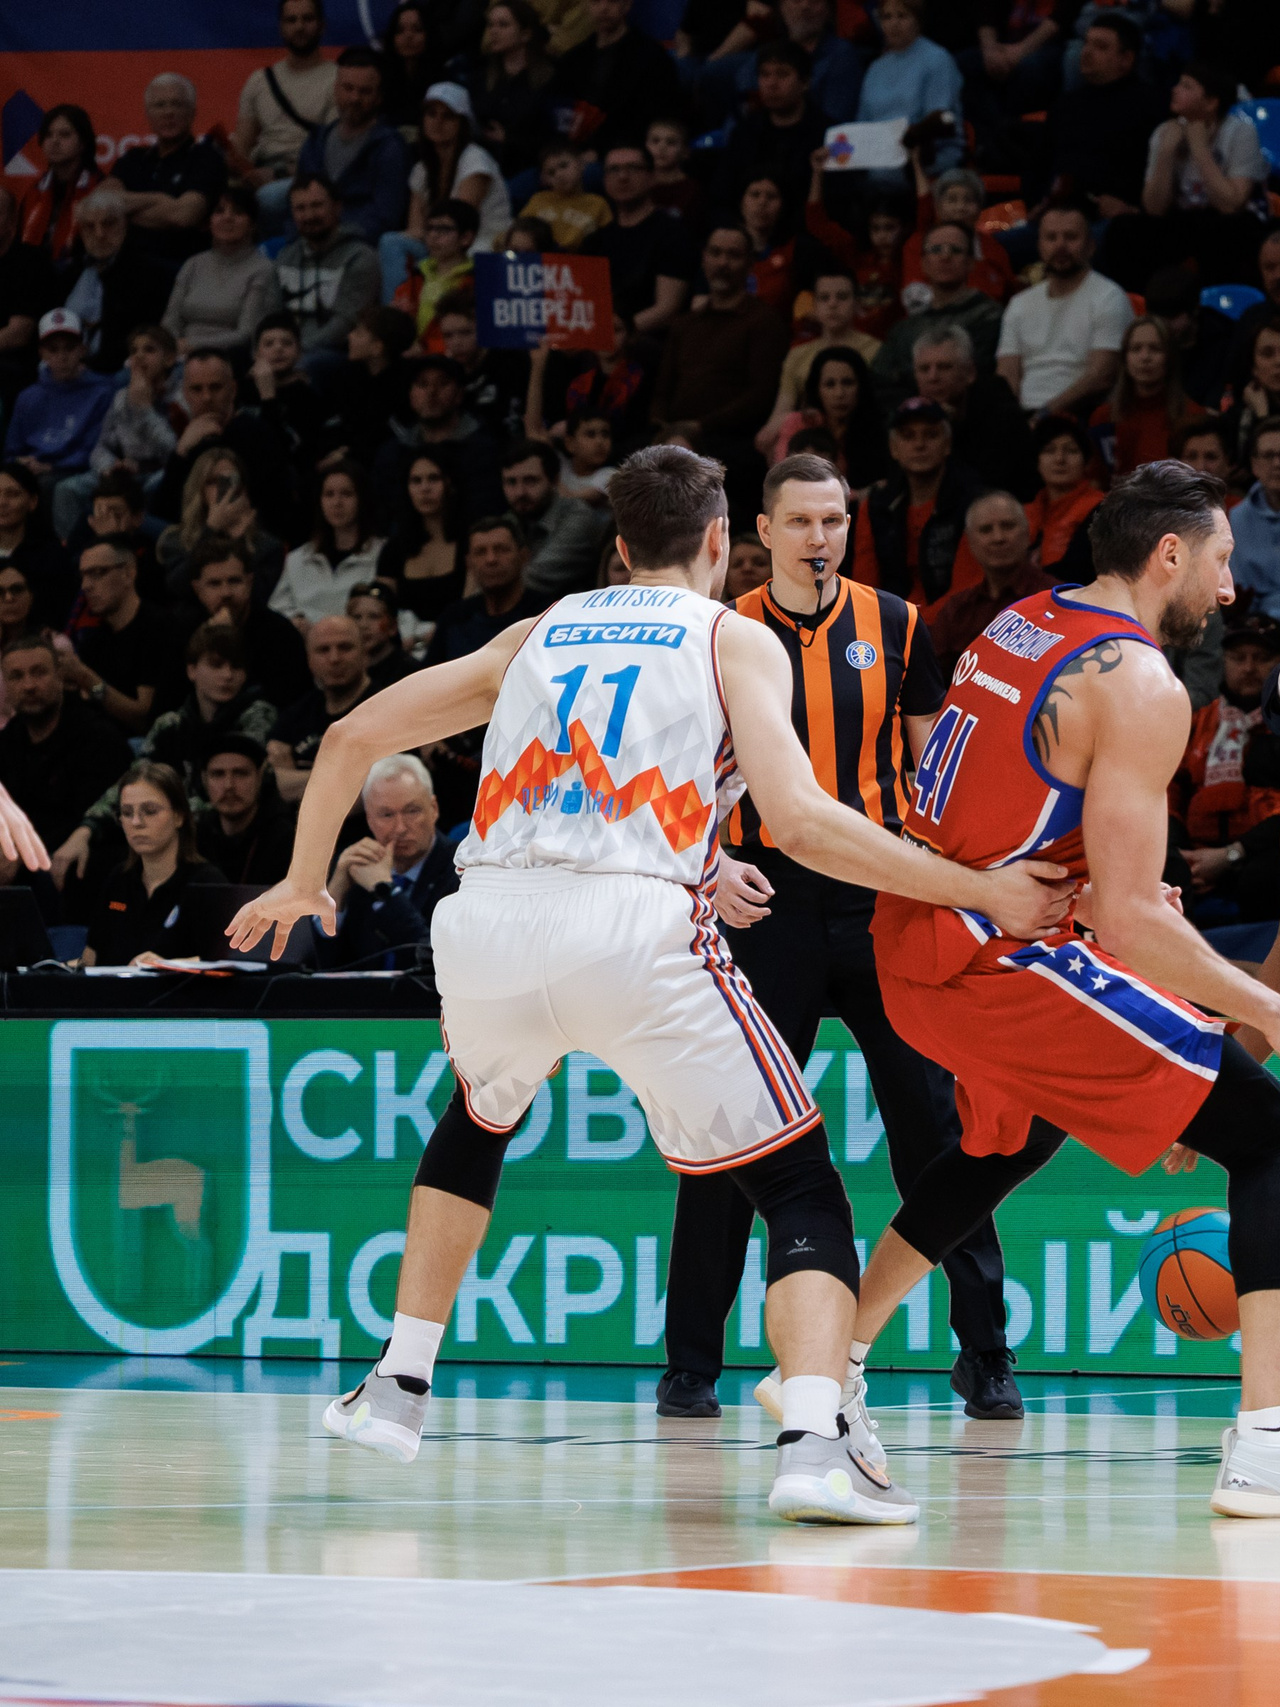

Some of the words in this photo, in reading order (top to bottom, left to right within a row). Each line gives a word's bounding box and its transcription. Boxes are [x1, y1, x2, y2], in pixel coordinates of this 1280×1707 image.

[582, 588, 687, 609] ILNITSKIY
[549, 625, 682, 644] БЕТСИТИ
[970, 669, 1022, 705] НОРНИКЕЛЬ
[549, 664, 642, 759] 11
[913, 703, 980, 826] 41
